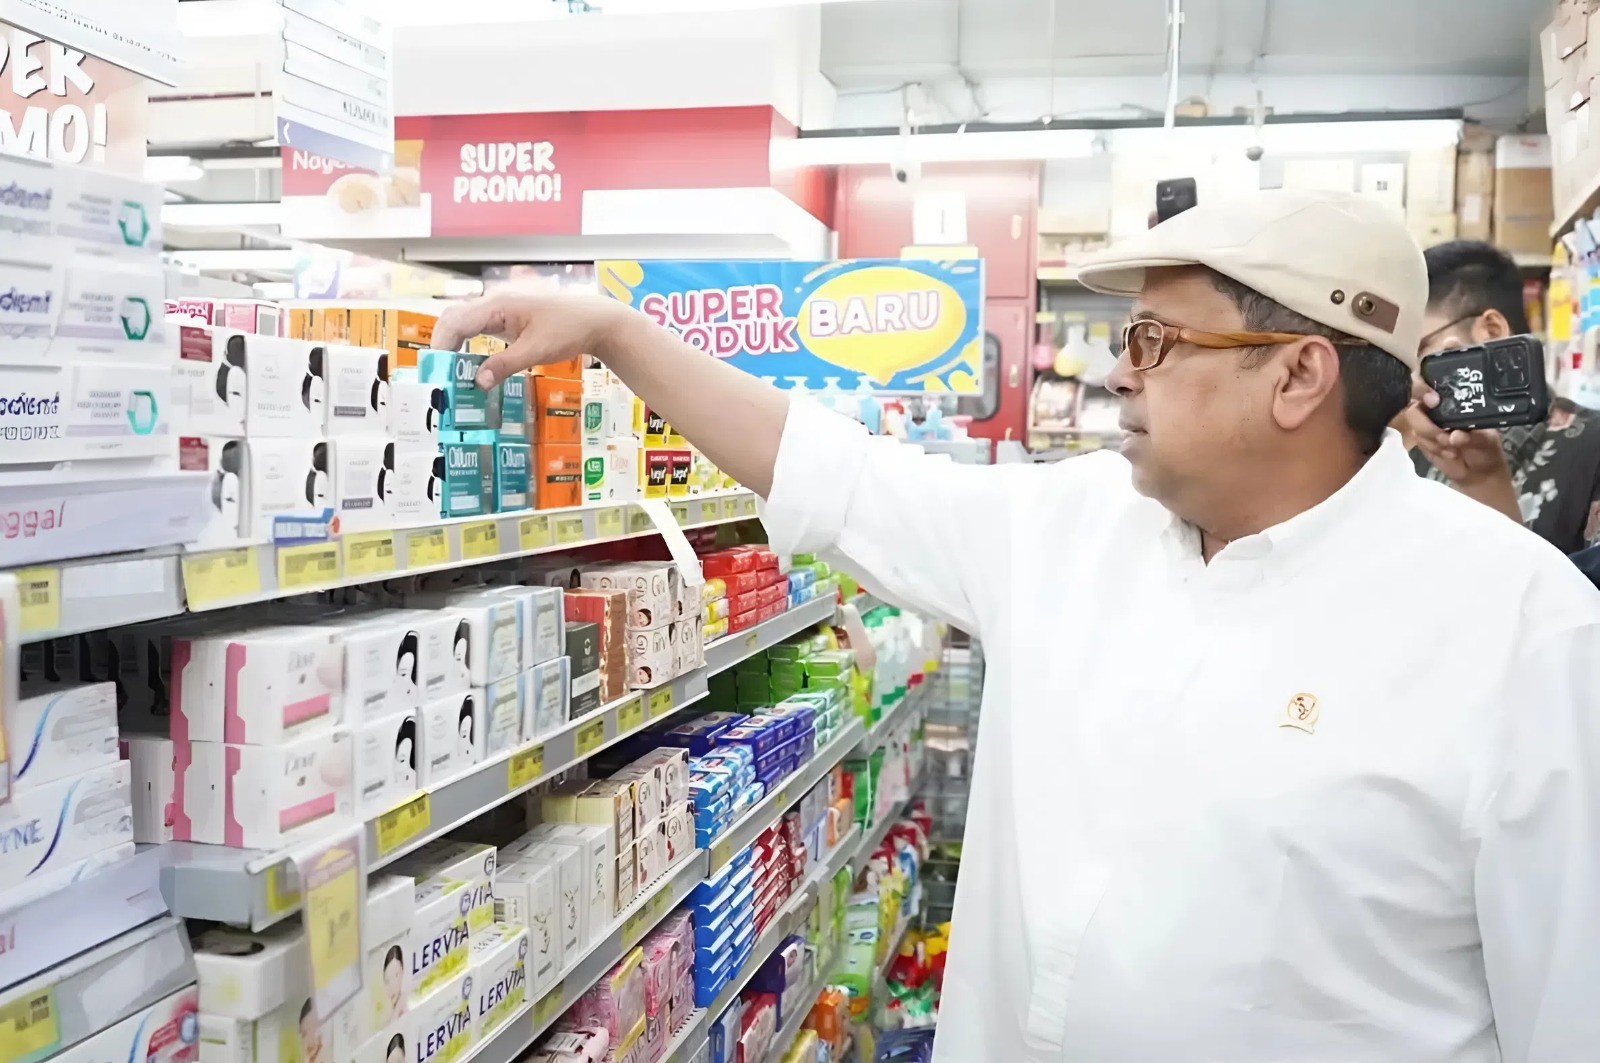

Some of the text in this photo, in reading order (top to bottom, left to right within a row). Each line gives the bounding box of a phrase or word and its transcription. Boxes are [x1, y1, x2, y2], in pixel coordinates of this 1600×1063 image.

[461, 141, 556, 174] SUPER
[453, 174, 561, 203] PROMO!
[641, 285, 783, 326] SUPER
[810, 291, 939, 337] BARU
[412, 920, 469, 975] LERVIA
[479, 964, 526, 1017] LERVIA
[417, 1005, 472, 1063] LERVIA
